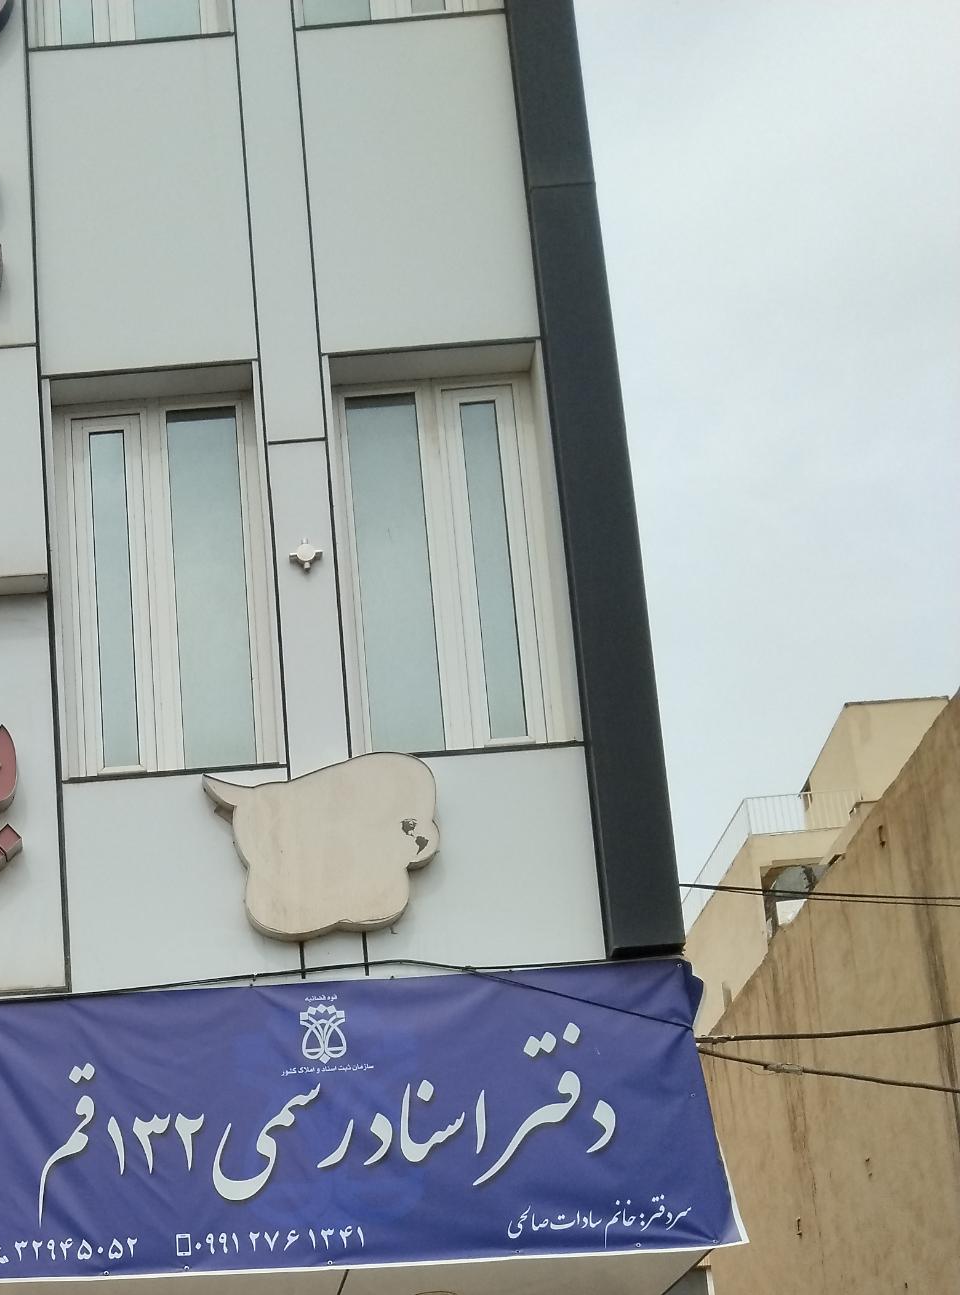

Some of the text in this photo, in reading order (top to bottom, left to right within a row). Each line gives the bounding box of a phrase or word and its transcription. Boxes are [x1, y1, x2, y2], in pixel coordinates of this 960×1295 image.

[37, 1021, 617, 1228] دفتر اسناد رسمی ۱۳۲ قم
[506, 1204, 549, 1240] صالحی
[549, 1210, 603, 1231] سادات
[603, 1199, 637, 1249] خانم
[13, 1236, 138, 1262] ۳۲۹۴۵۰۵۲
